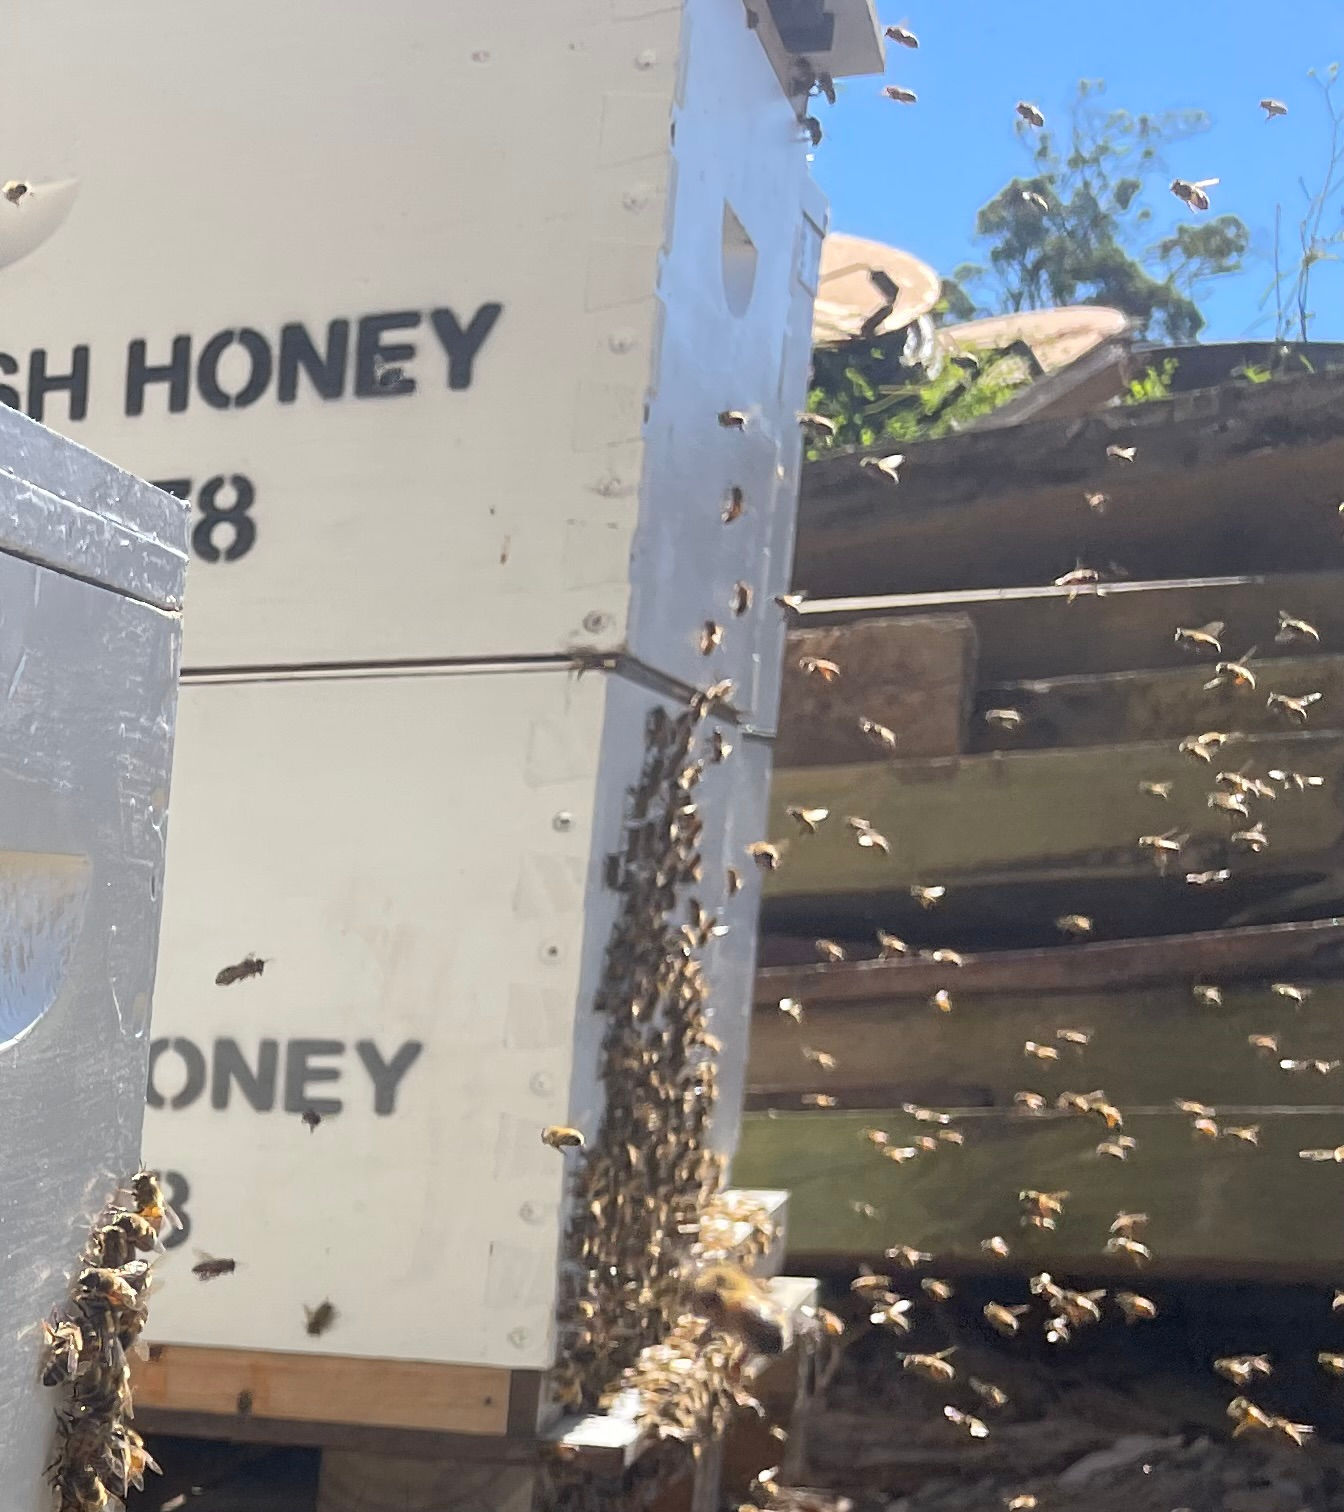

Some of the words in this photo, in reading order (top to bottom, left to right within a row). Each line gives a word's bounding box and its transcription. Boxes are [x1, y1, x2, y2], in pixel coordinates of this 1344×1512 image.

[124, 302, 503, 417] HONEY
[150, 473, 257, 564] 8
[147, 1036, 423, 1117] ONEY
